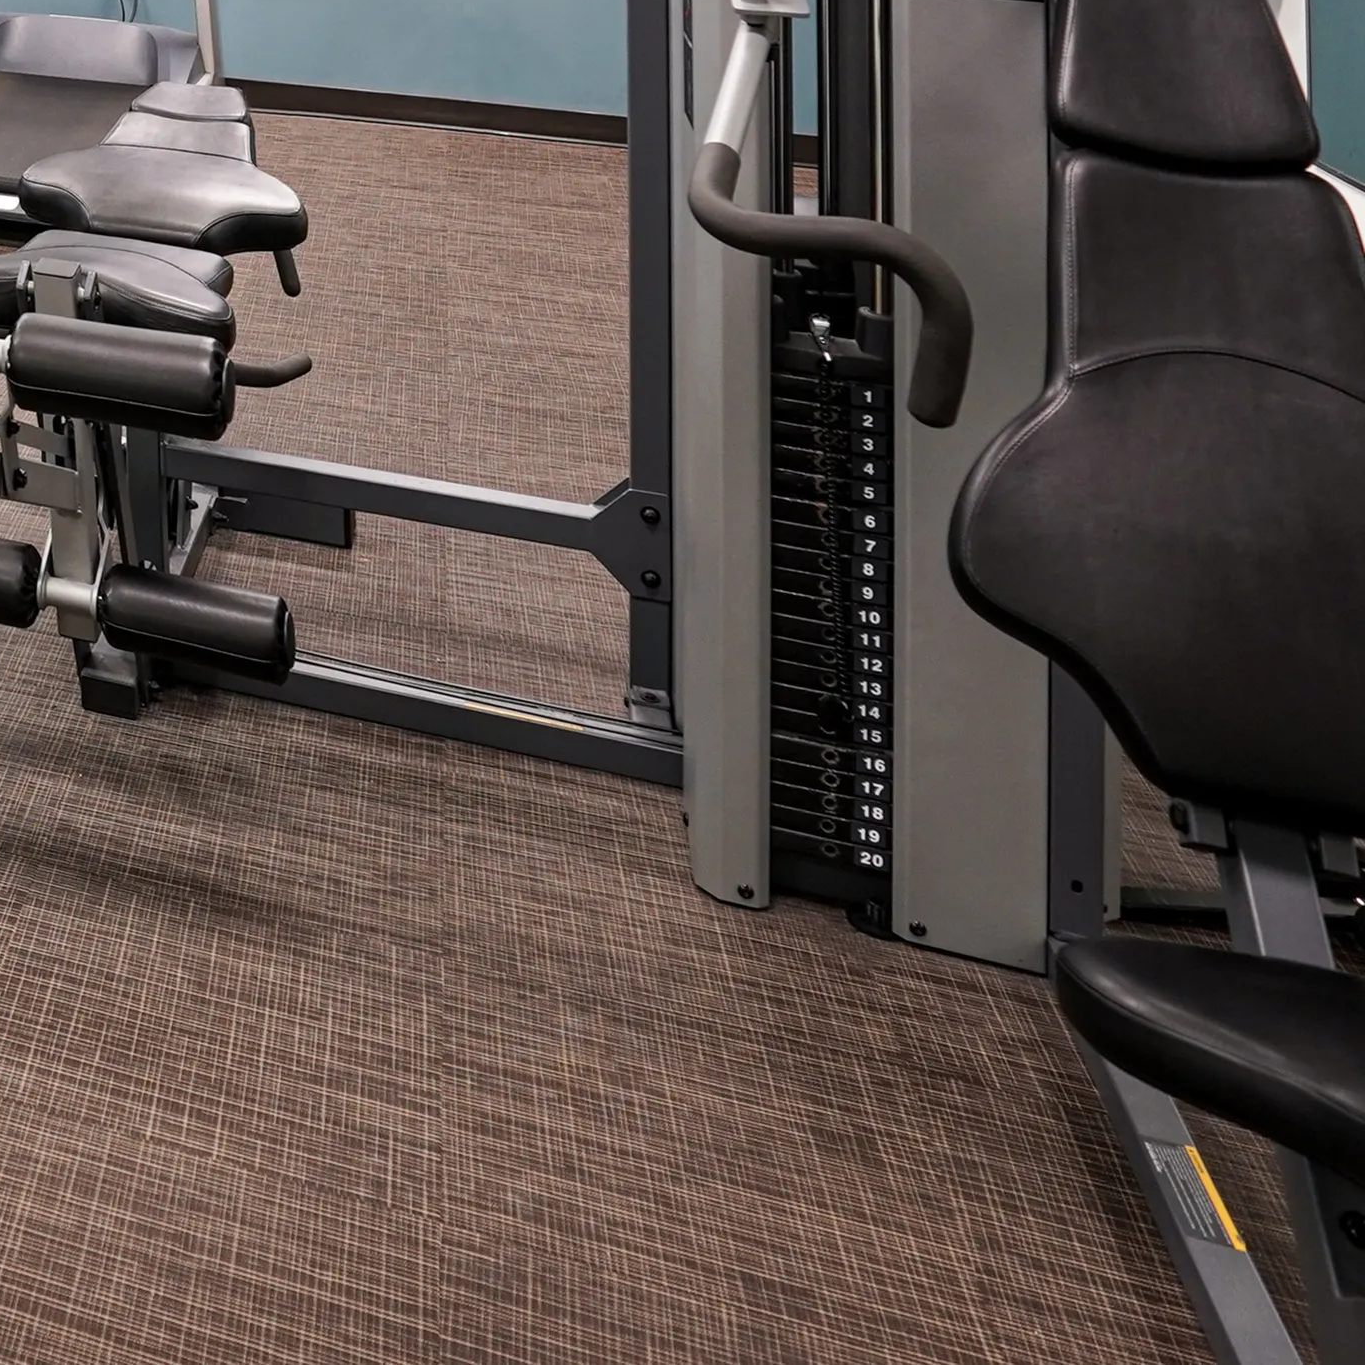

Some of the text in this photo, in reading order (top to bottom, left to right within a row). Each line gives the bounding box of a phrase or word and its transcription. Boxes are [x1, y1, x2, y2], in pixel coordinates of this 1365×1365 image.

[864, 391, 872, 403] 1
[862, 414, 873, 428] 2
[862, 438, 874, 451] 3
[863, 463, 875, 475] 4
[863, 486, 875, 499] 5
[864, 515, 876, 528] 6
[864, 539, 877, 553] 7
[862, 562, 875, 576] 8
[862, 586, 874, 600] 9
[858, 610, 881, 625] 10
[860, 633, 881, 648] 11
[860, 657, 883, 673] 12
[859, 681, 882, 696] 13
[858, 704, 881, 719] 14
[860, 728, 882, 743] 15
[863, 757, 886, 773] 16
[861, 781, 885, 796] 17
[861, 805, 884, 821] 18
[857, 827, 880, 843] 19
[860, 851, 884, 868] 20
